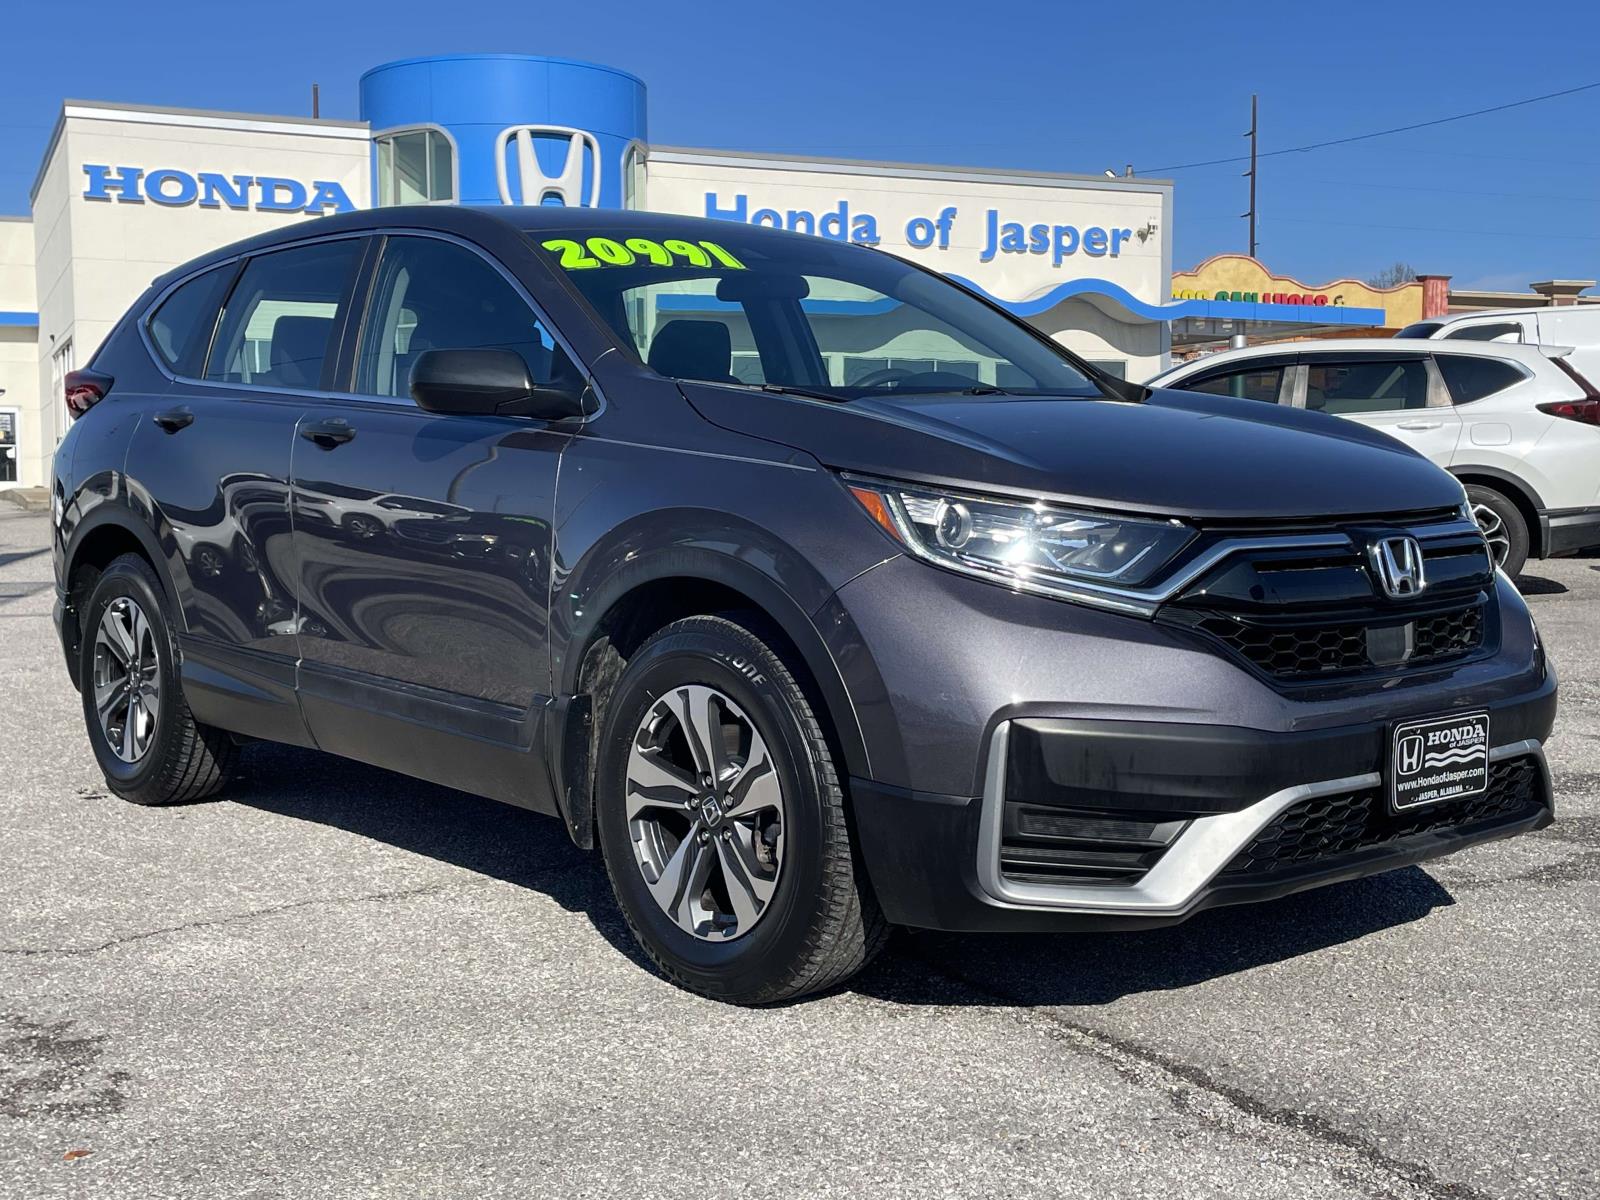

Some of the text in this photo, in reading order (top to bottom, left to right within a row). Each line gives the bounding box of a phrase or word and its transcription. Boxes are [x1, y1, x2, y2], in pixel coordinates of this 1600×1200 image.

[83, 164, 357, 216] HONDA
[705, 192, 1133, 268] Honda of Jasper
[541, 237, 747, 269] 20991
[1427, 724, 1486, 746] HONDA
[1457, 736, 1485, 747] JASPER
[1397, 767, 1485, 792] www.HondaofJasper.com
[1439, 784, 1464, 797] ALABAMA
